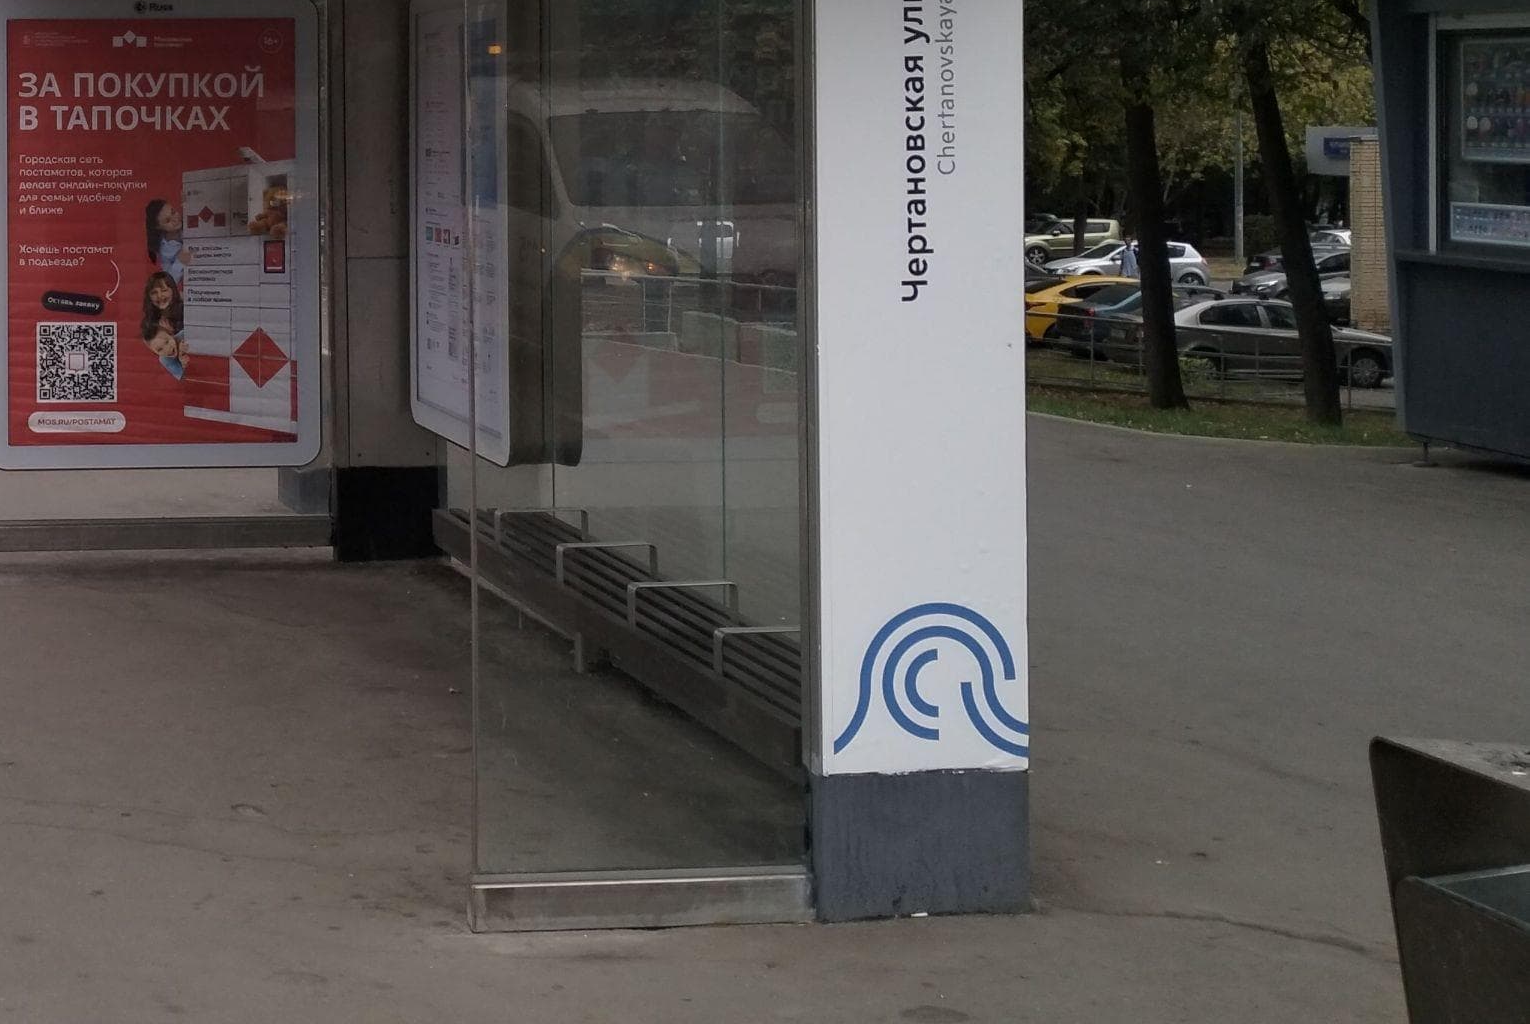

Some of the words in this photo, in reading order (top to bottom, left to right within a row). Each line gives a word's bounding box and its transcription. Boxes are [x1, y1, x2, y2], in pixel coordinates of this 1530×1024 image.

[18, 72, 62, 98] ЗА
[73, 65, 265, 98] ПОКУПКОЙ
[19, 105, 39, 131] В
[50, 105, 230, 131] ТАПОЧКАХ
[19, 154, 77, 166] Городская
[79, 156, 104, 164] сеть
[19, 168, 86, 178] постаматов,
[88, 169, 133, 179] которая
[901, 55, 935, 303] Чертановская
[19, 181, 56, 190] делает
[58, 179, 148, 191] онлайн-покупки
[18, 194, 38, 203] для
[40, 195, 74, 203] семьи
[76, 193, 122, 204] удобнее
[19, 207, 27, 216] и
[28, 205, 64, 215] ближе
[18, 244, 60, 254] Хочешь
[62, 246, 114, 254] постамат
[19, 258, 26, 266] в
[28, 256, 86, 267] подъезде?
